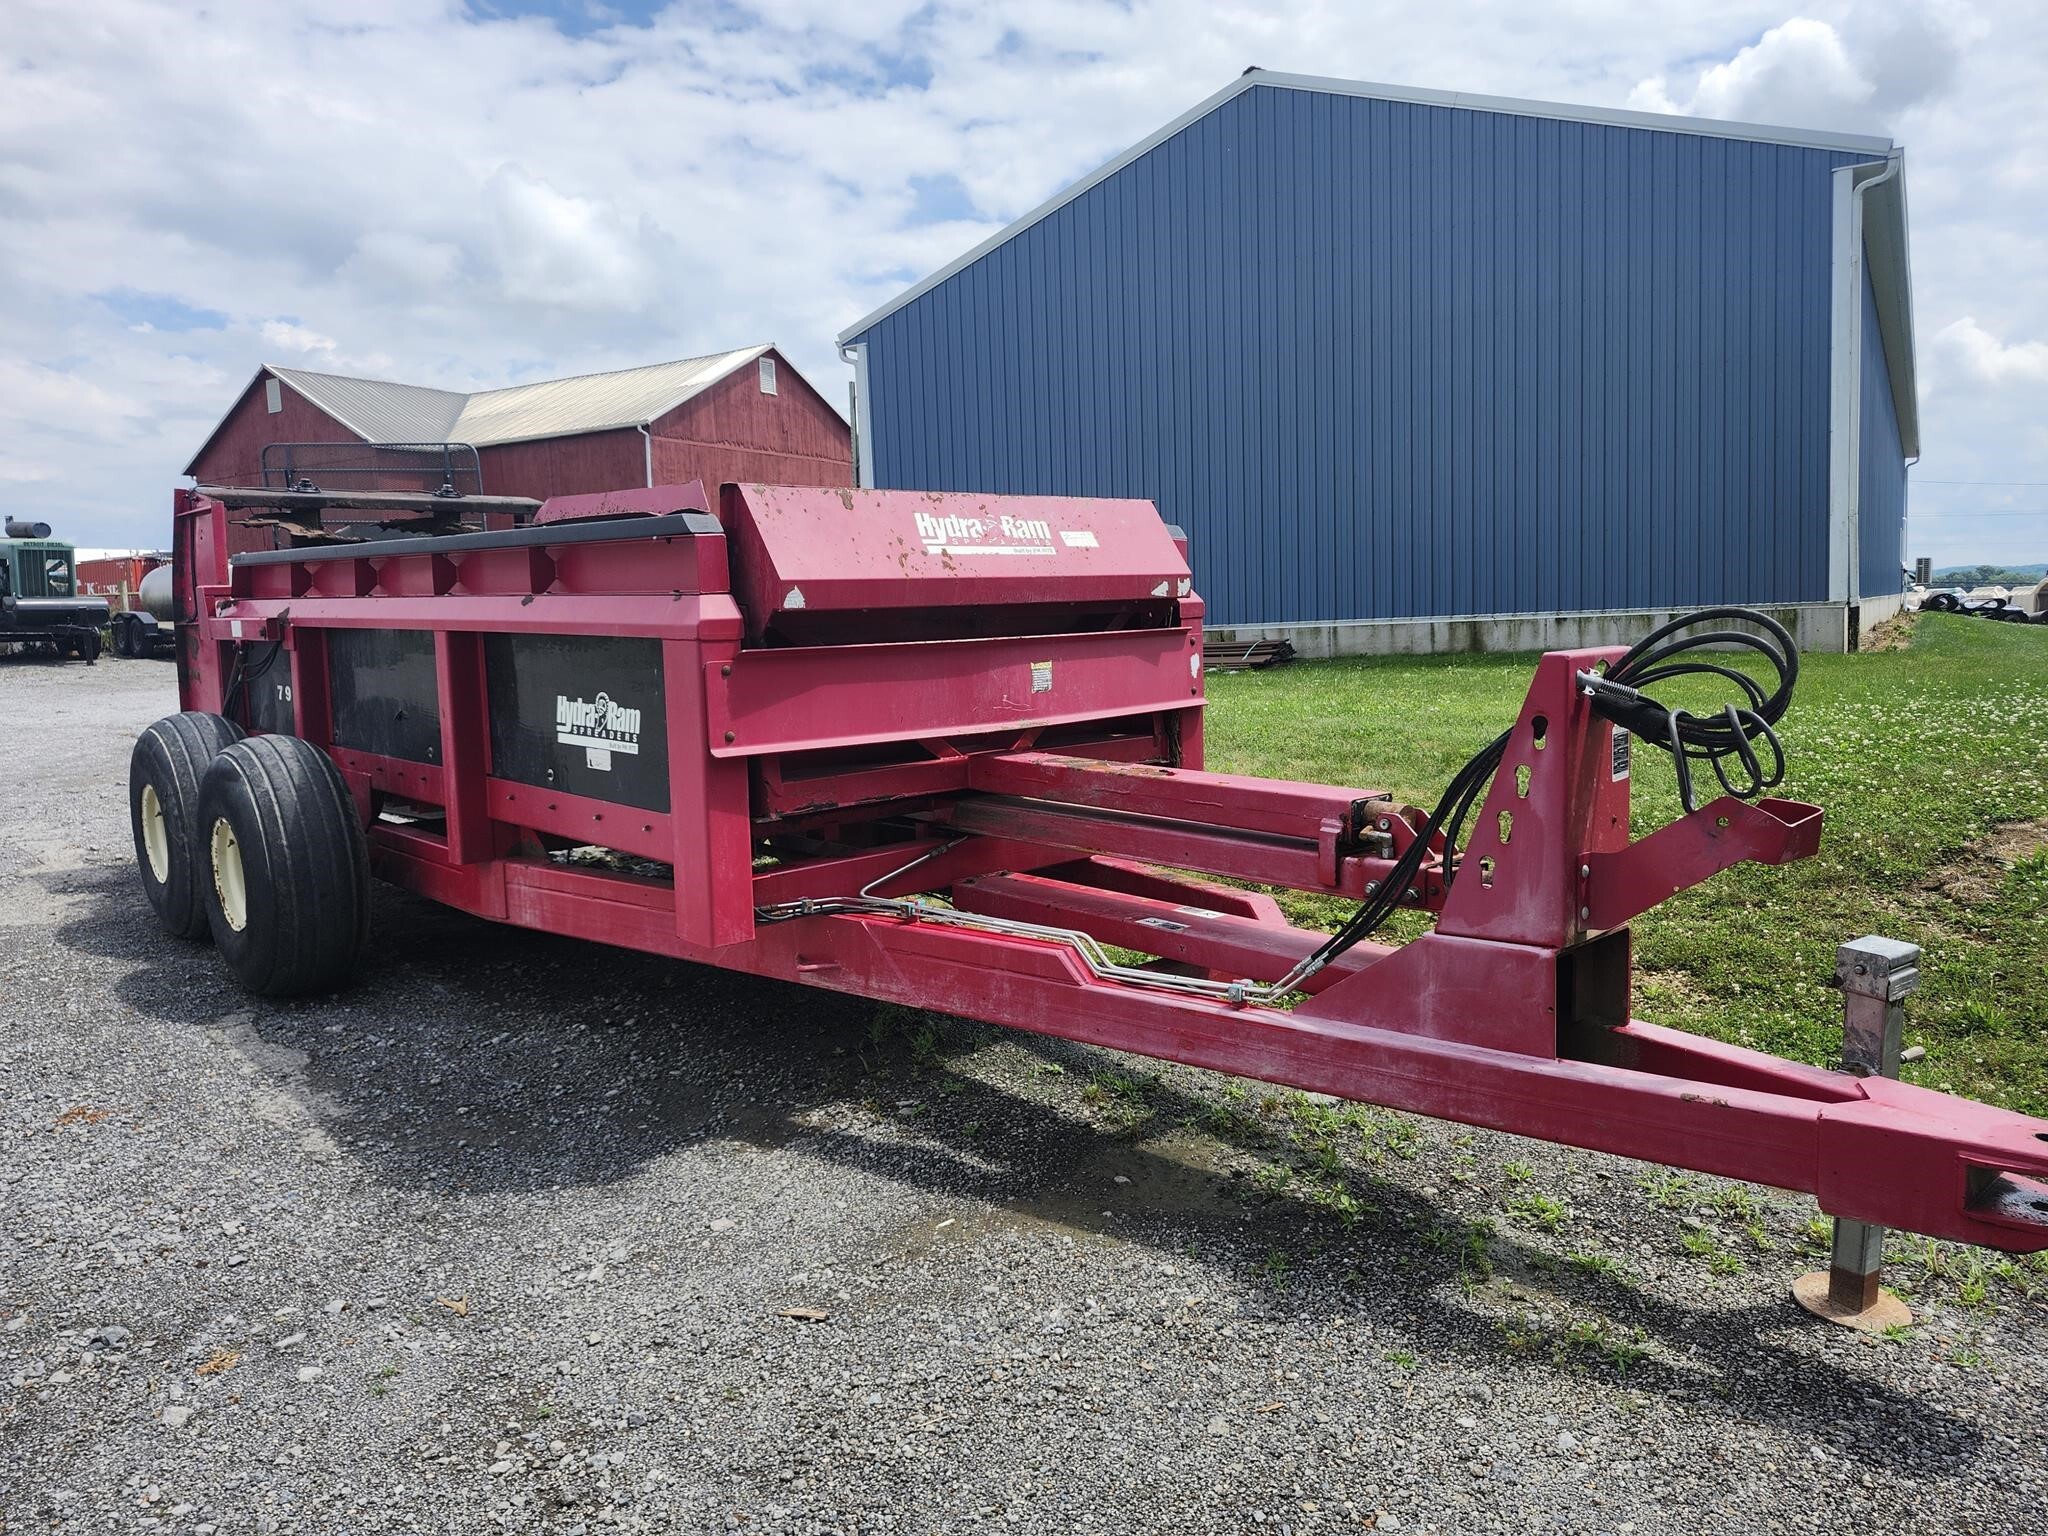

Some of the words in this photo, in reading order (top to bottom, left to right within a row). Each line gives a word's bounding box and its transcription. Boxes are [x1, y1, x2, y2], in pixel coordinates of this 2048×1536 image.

[914, 512, 984, 545] Hydra
[999, 515, 1052, 539] Ram
[276, 685, 292, 701] 79
[556, 695, 597, 733] Hydra
[606, 701, 641, 735] Ram
[572, 726, 638, 743] SPREADERS
